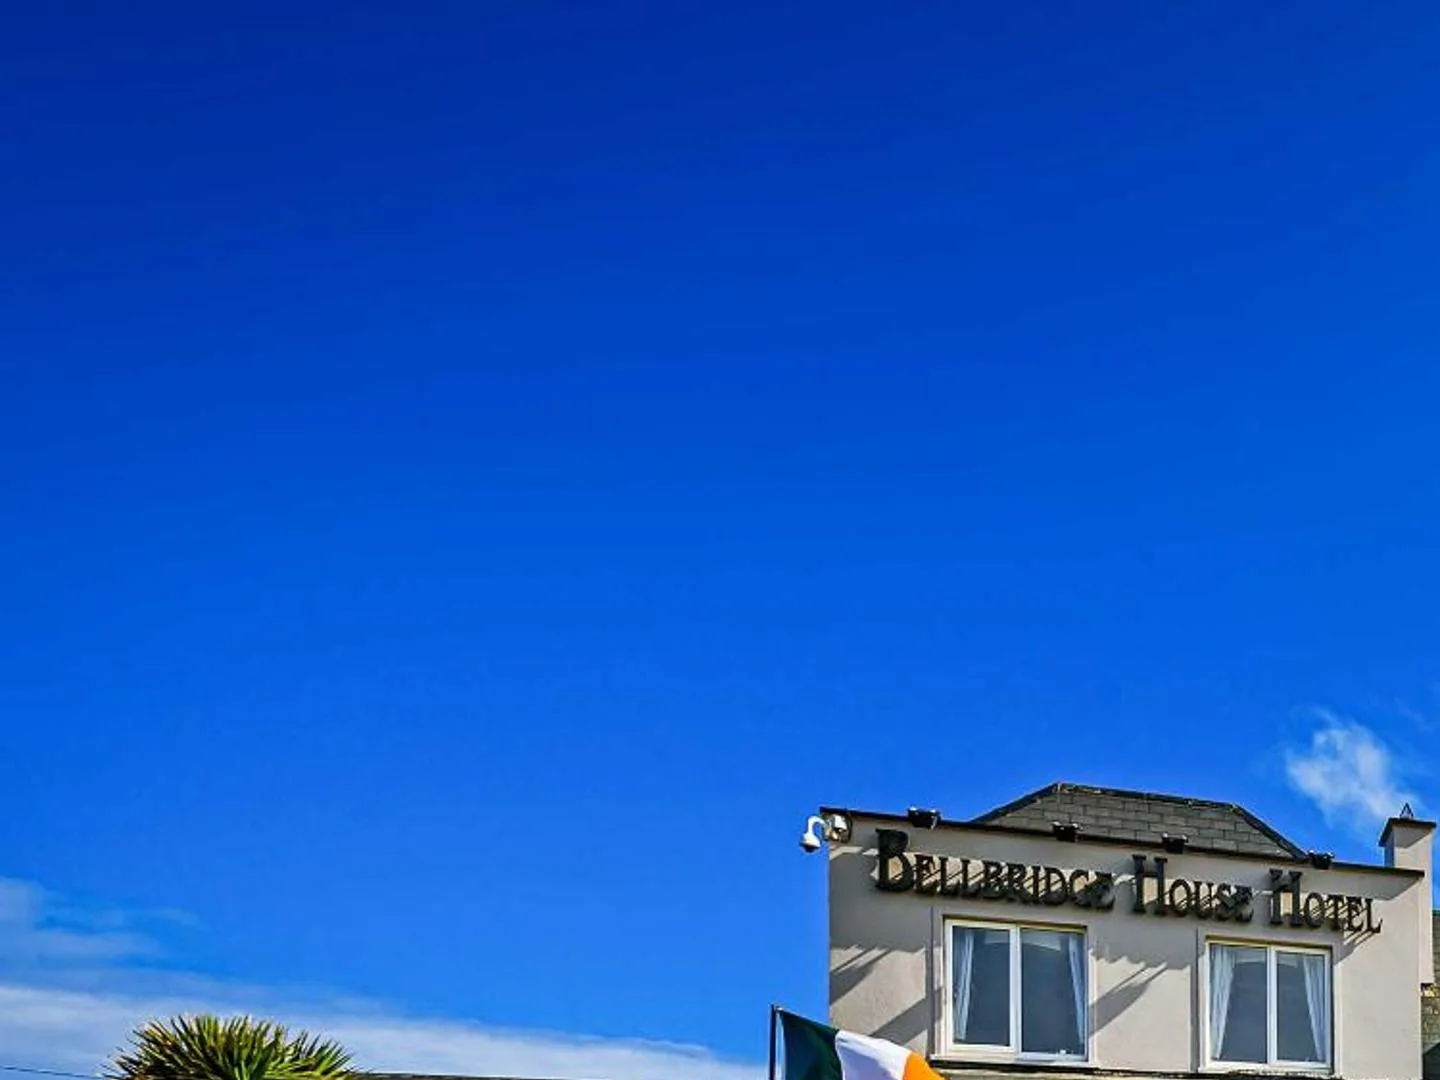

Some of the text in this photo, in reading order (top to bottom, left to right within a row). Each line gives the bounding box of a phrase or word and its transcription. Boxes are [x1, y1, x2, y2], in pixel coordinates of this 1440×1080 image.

[875, 828, 1383, 934] BELLBRIDGE HOUSE HOTEL
